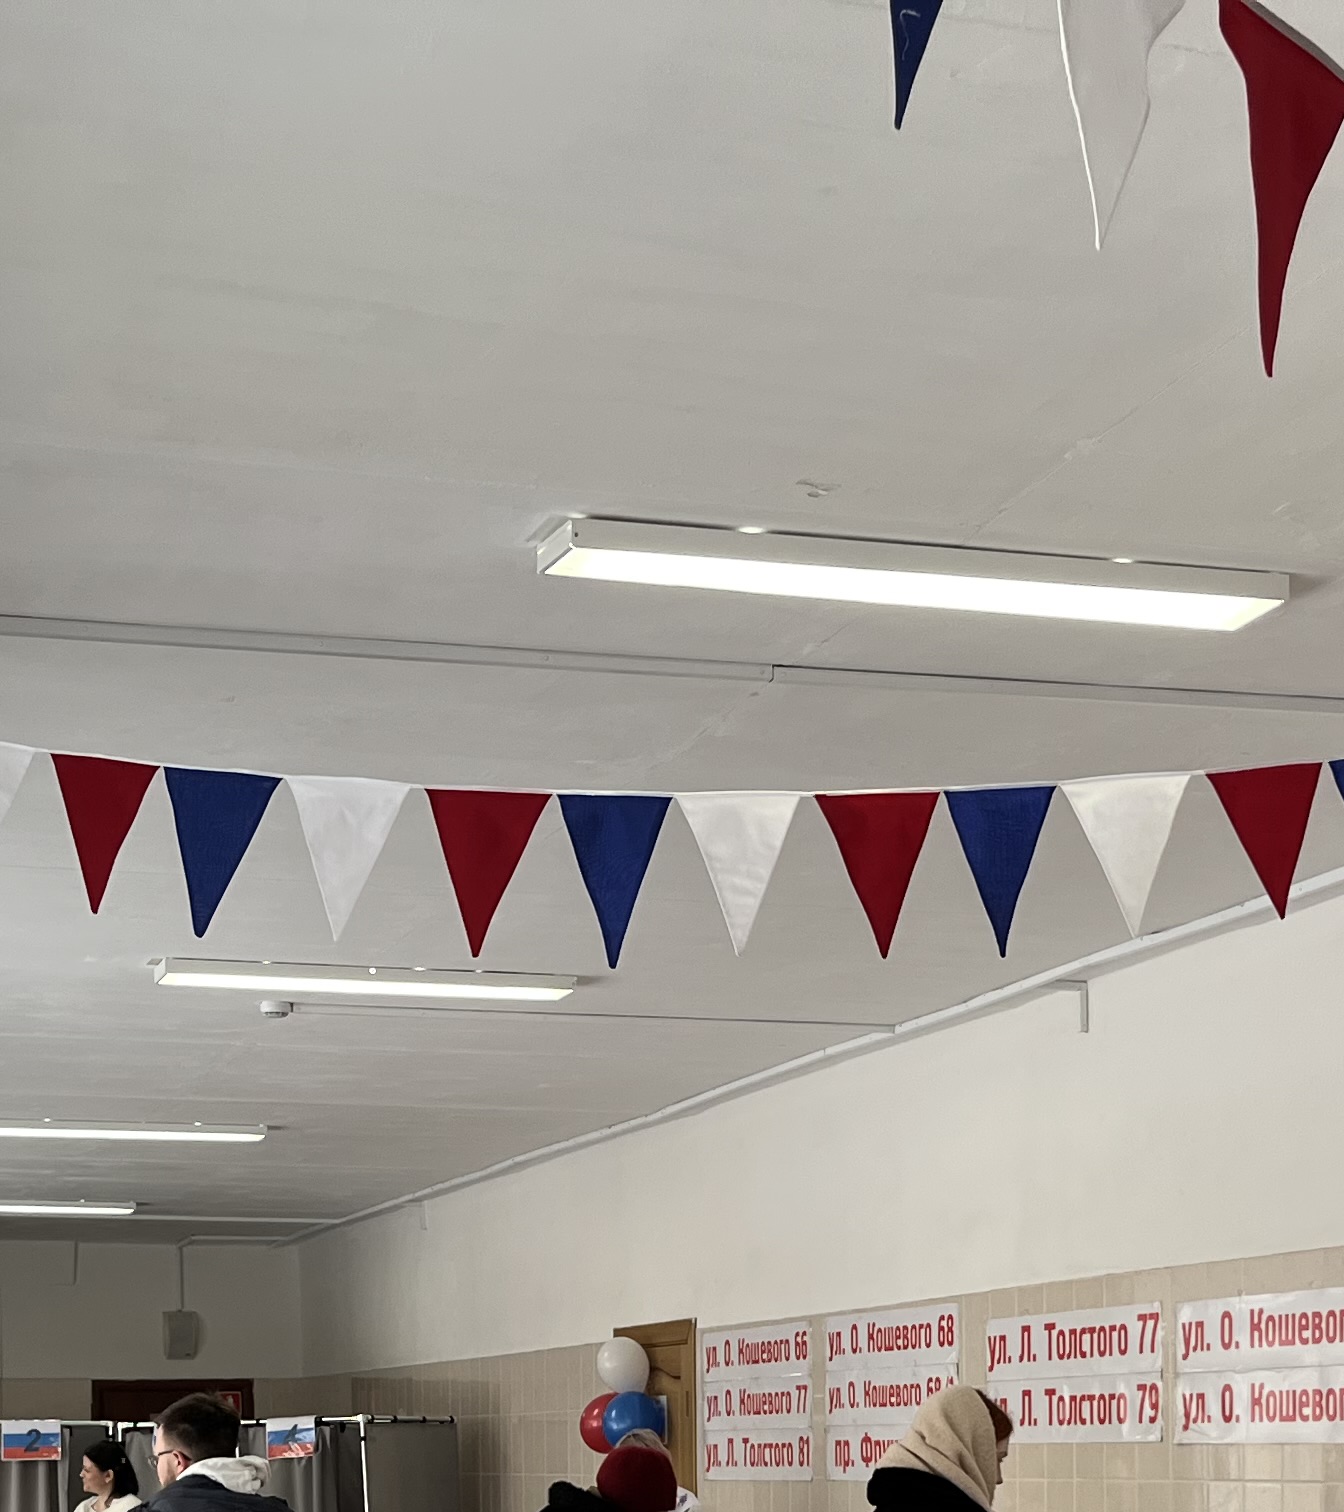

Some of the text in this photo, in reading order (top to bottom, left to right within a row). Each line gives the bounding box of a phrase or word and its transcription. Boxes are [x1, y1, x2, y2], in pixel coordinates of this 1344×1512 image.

[706, 1331, 808, 1372] ул. О. Кошевого 66
[828, 1314, 955, 1361] ул. О. Кошевого 68
[988, 1312, 1160, 1372] ул. Л. Толстого 77
[1182, 1320, 1212, 1360] ул.
[1220, 1311, 1241, 1351] О.
[707, 1384, 808, 1422] ул. О. Кошевого 77
[828, 1386, 845, 1414] ул.
[848, 1381, 860, 1409] О.
[863, 1380, 922, 1409] Кошевого
[1019, 1389, 1038, 1427] Л.
[1044, 1388, 1127, 1426] Толстого
[1137, 1382, 1160, 1424] 79
[1182, 1391, 1212, 1432] ул.
[1220, 1384, 1241, 1424] О.
[23, 1428, 43, 1453] 2
[706, 1436, 811, 1472] ул. Л. Толстого 81
[835, 1440, 854, 1473] пр.
